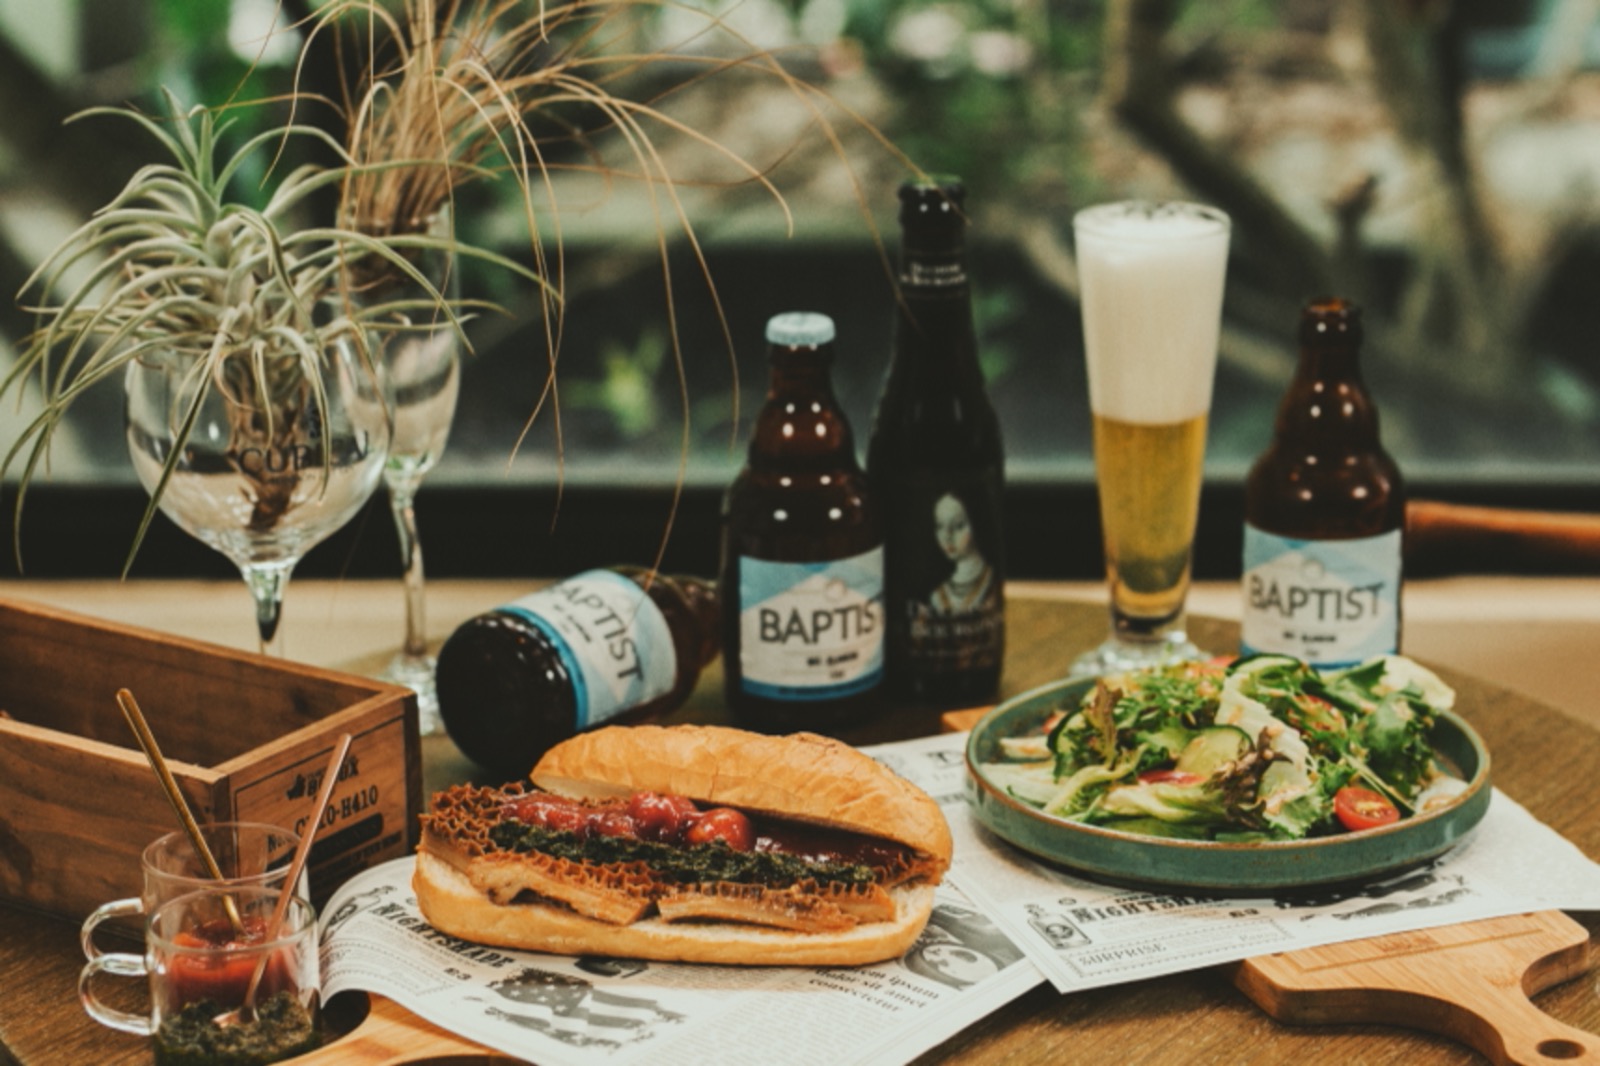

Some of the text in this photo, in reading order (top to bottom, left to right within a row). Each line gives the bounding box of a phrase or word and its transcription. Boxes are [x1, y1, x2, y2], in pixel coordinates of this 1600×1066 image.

[760, 592, 881, 645] BAPTIS
[1250, 574, 1385, 621] BAPTIST
[556, 585, 645, 682] APTIST
